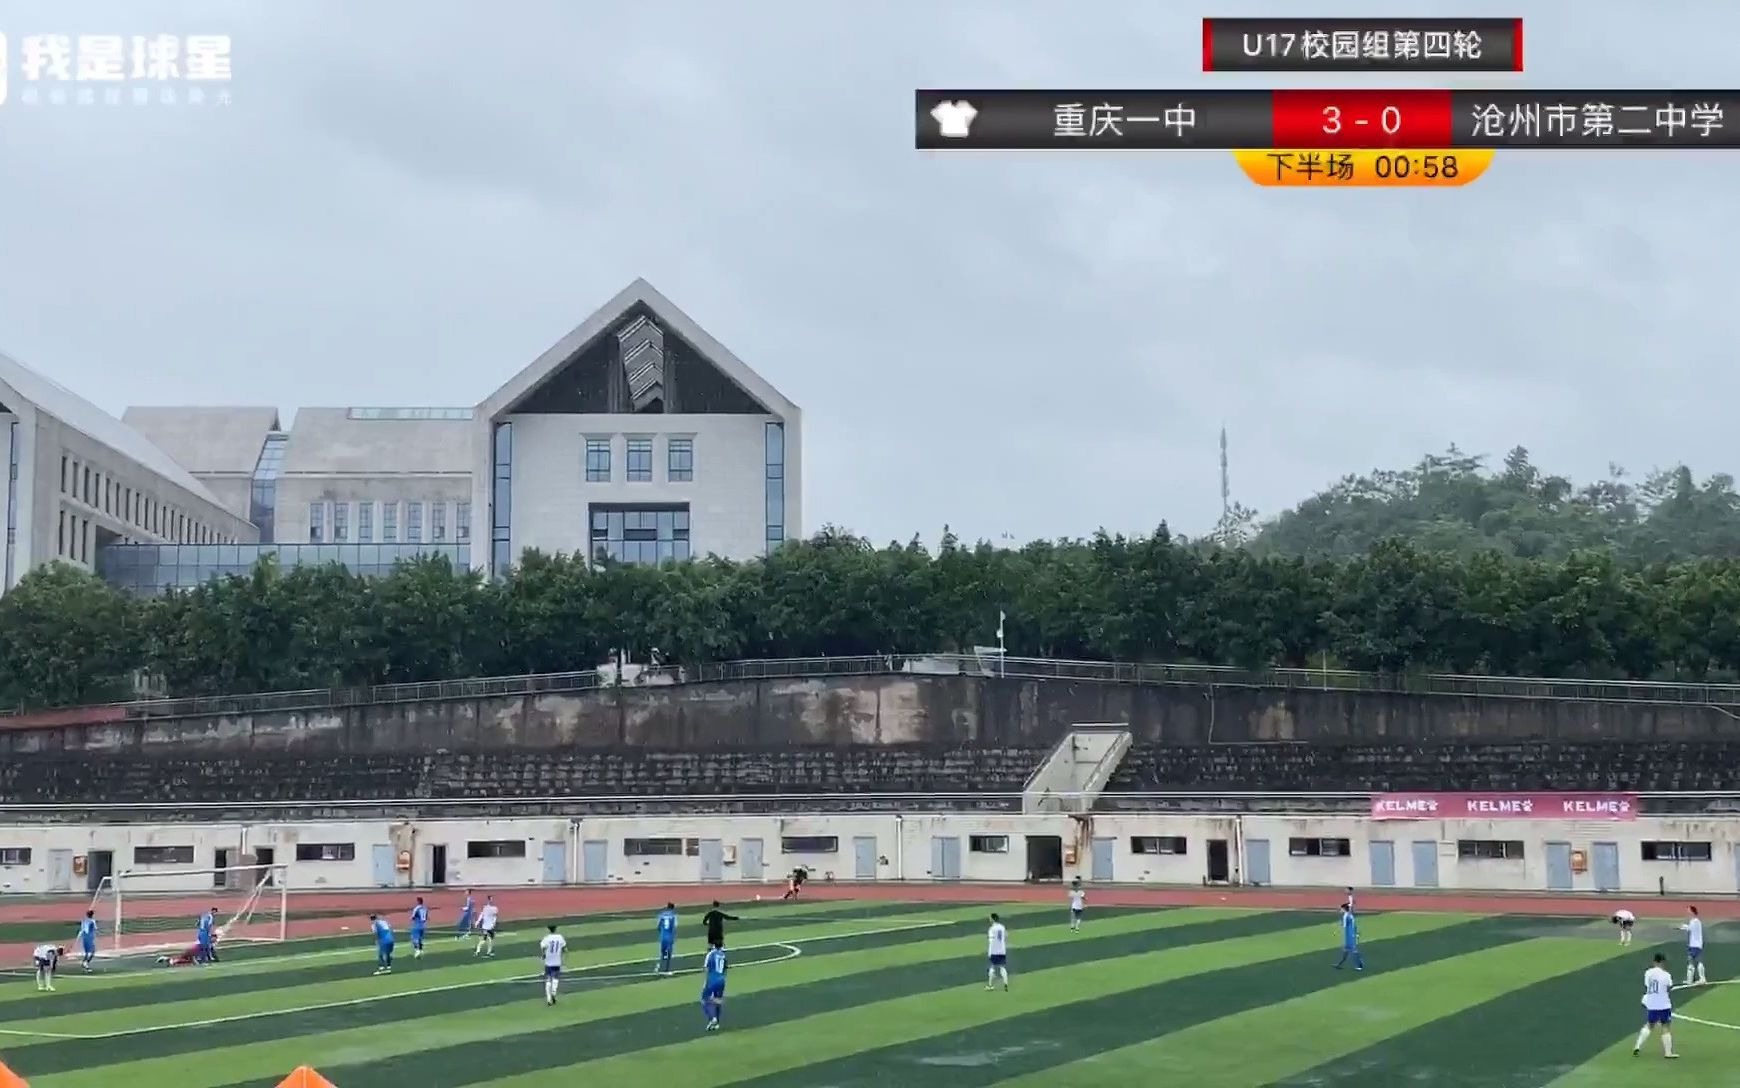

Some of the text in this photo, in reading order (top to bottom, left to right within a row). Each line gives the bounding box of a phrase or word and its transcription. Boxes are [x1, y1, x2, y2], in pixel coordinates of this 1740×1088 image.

[1374, 800, 1618, 812] KELME KELME KELME
